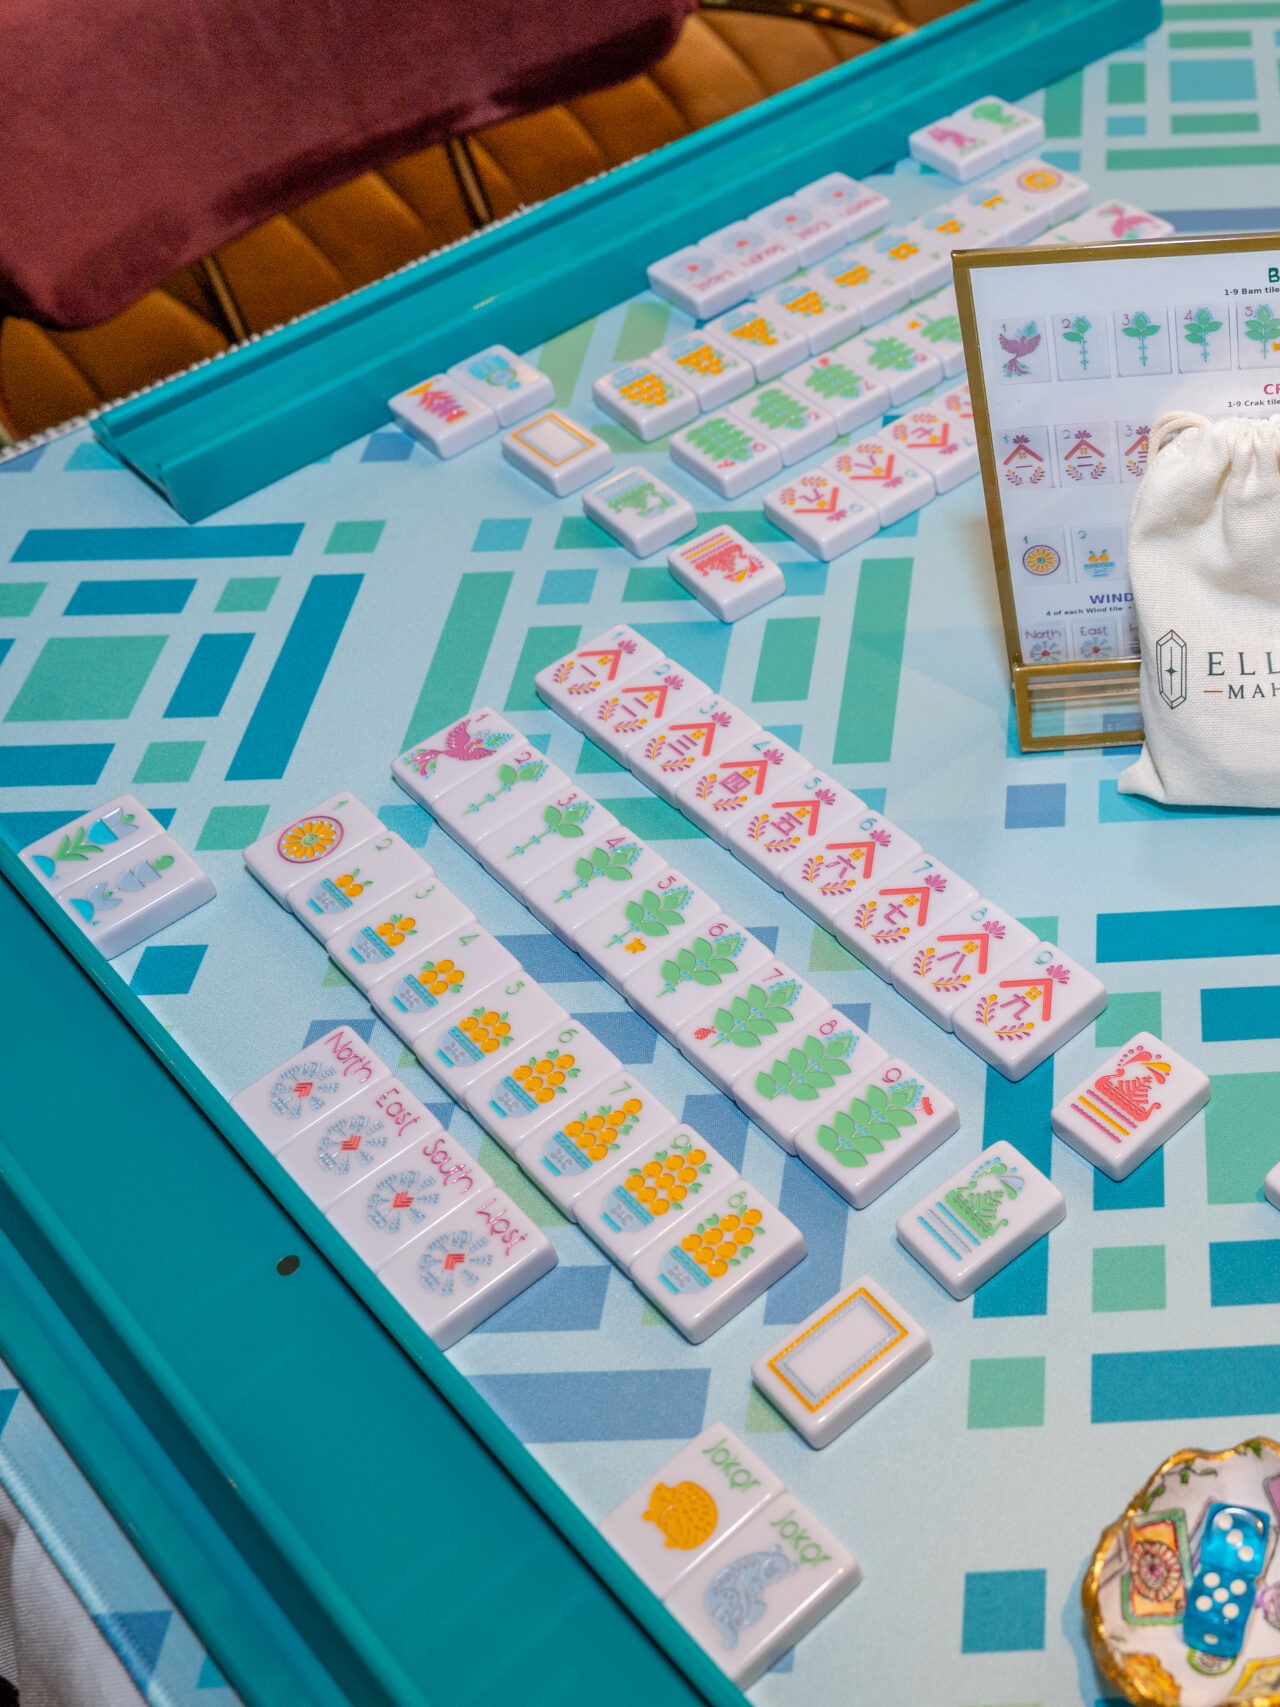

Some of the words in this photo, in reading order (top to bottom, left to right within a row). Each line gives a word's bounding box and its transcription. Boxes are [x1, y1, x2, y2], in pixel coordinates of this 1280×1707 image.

[1224, 288, 1239, 296] 1-9
[1241, 287, 1262, 295] Bam
[1183, 310, 1193, 322] 4
[1244, 306, 1254, 318] 5
[1061, 318, 1071, 330] 2
[1121, 313, 1131, 326] 3
[1227, 400, 1242, 408] 1-9
[1244, 399, 1265, 407] Crak
[1125, 424, 1133, 437] 3
[1089, 592, 1134, 605] WIND
[1086, 606, 1107, 614] Wind
[1025, 628, 1062, 640] North
[1080, 625, 1109, 637] East
[654, 663, 671, 676] 2
[699, 701, 719, 715] 3
[752, 739, 772, 752] 4
[514, 751, 532, 764] 2
[804, 777, 823, 790] 5
[557, 793, 577, 807] 3
[858, 817, 879, 832] 6
[375, 838, 393, 852] 2
[605, 837, 627, 849] 4
[913, 860, 934, 874] 7
[657, 875, 677, 890] 5
[415, 885, 436, 900] 3
[970, 907, 988, 922] 8
[709, 922, 729, 937] 6
[458, 932, 481, 948] 4
[1034, 950, 1054, 965] 9
[761, 967, 784, 983] 7
[505, 980, 526, 995] 5
[819, 1019, 838, 1036] 8
[558, 1028, 579, 1044] 6
[324, 1031, 374, 1085] North
[882, 1067, 903, 1084] 9
[609, 1080, 633, 1096] 7
[375, 1087, 423, 1137] East
[670, 1133, 692, 1151] 9
[422, 1138, 475, 1195] South
[727, 1190, 748, 1208] 8
